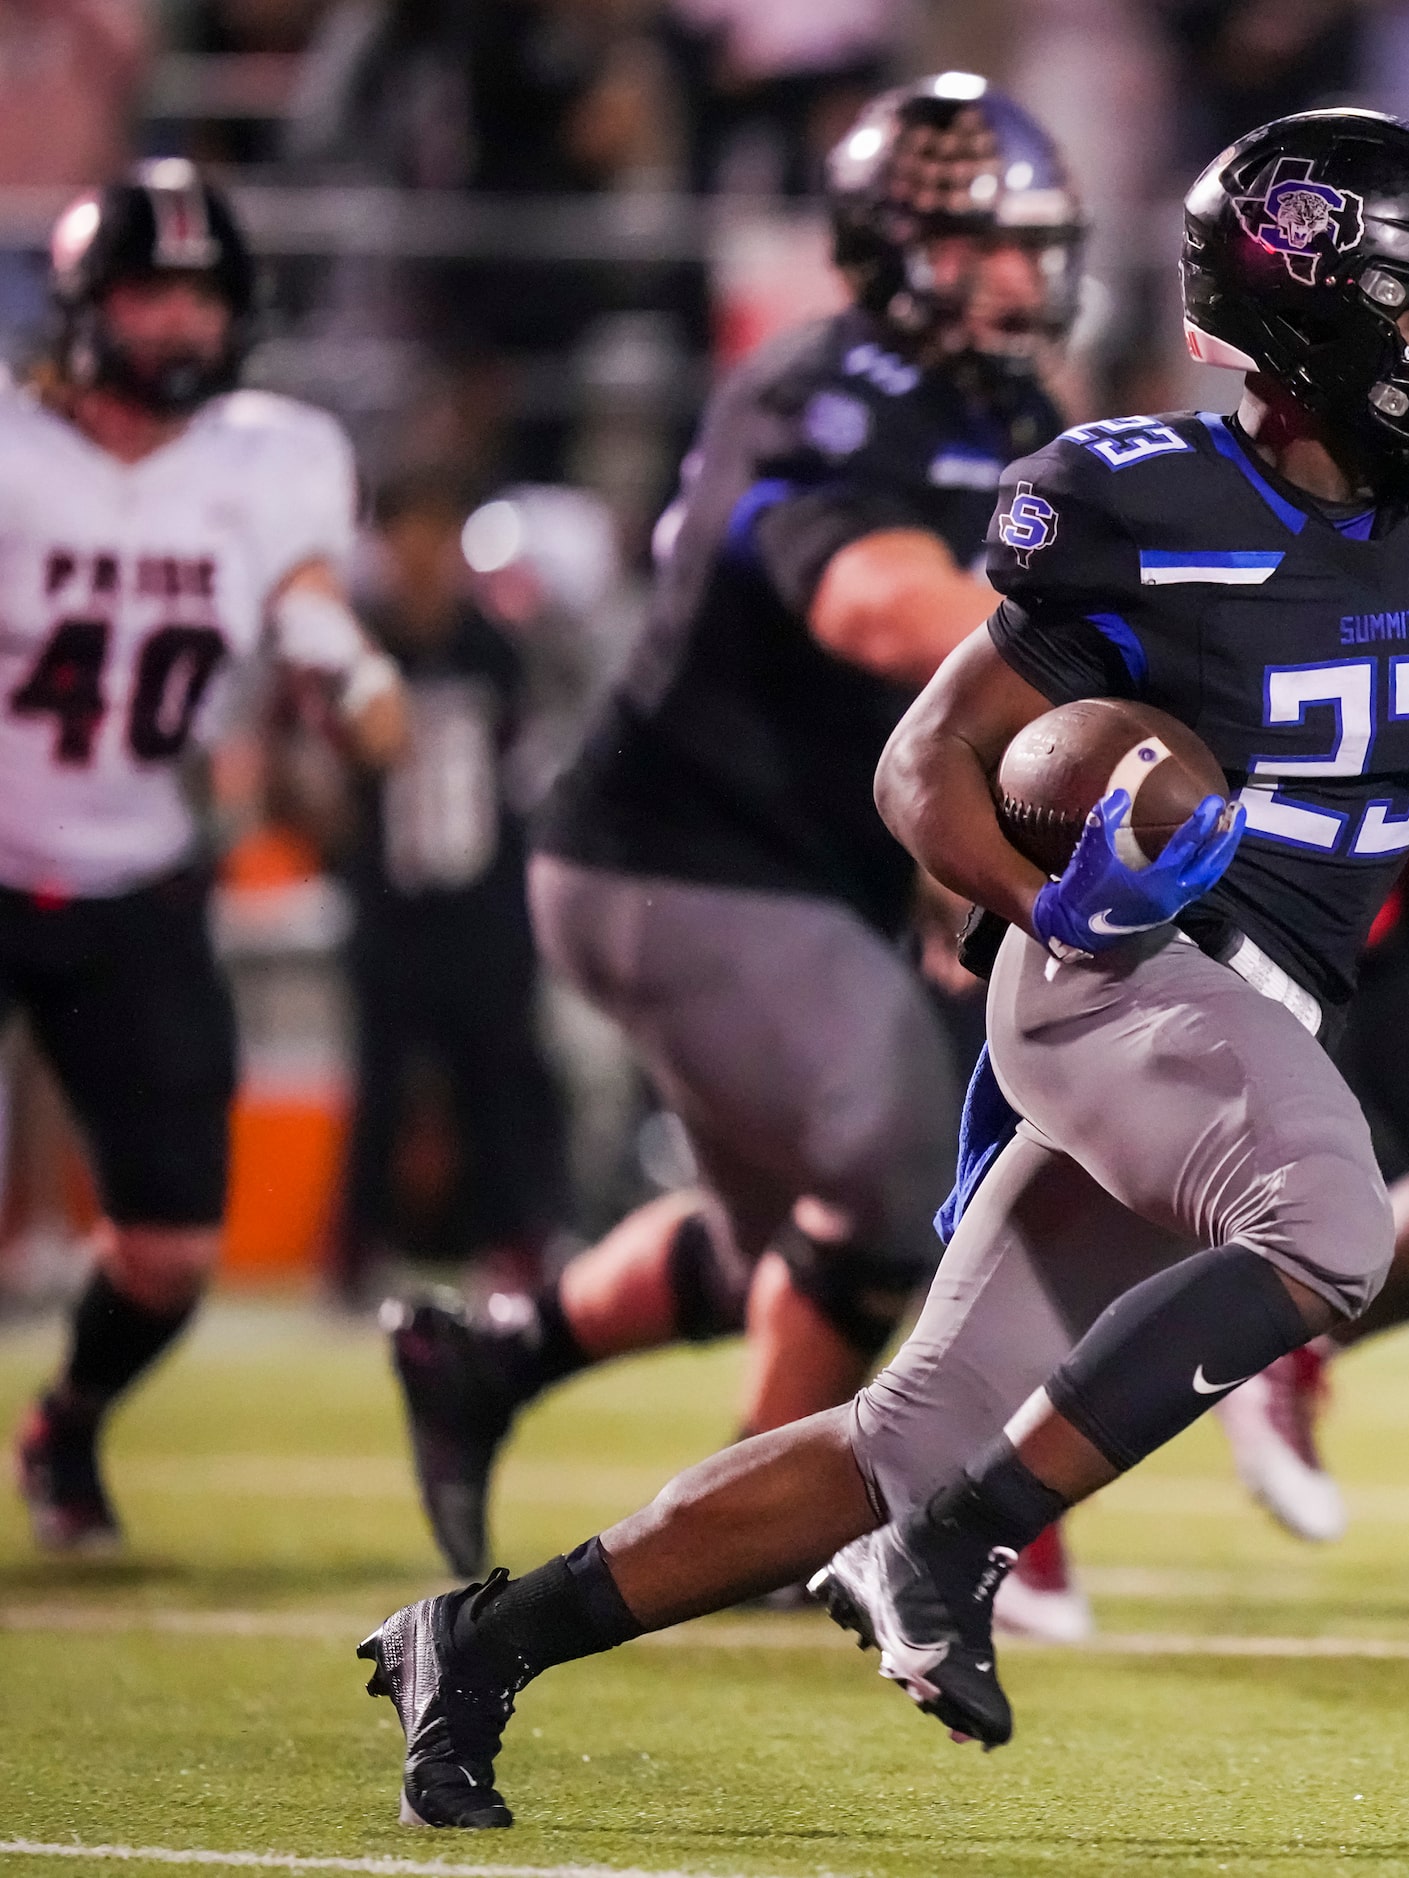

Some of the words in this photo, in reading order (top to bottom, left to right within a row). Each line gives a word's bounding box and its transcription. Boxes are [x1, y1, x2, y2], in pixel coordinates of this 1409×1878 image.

[1056, 415, 1198, 473] 23
[1003, 493, 1054, 550] S
[10, 617, 227, 764] 40
